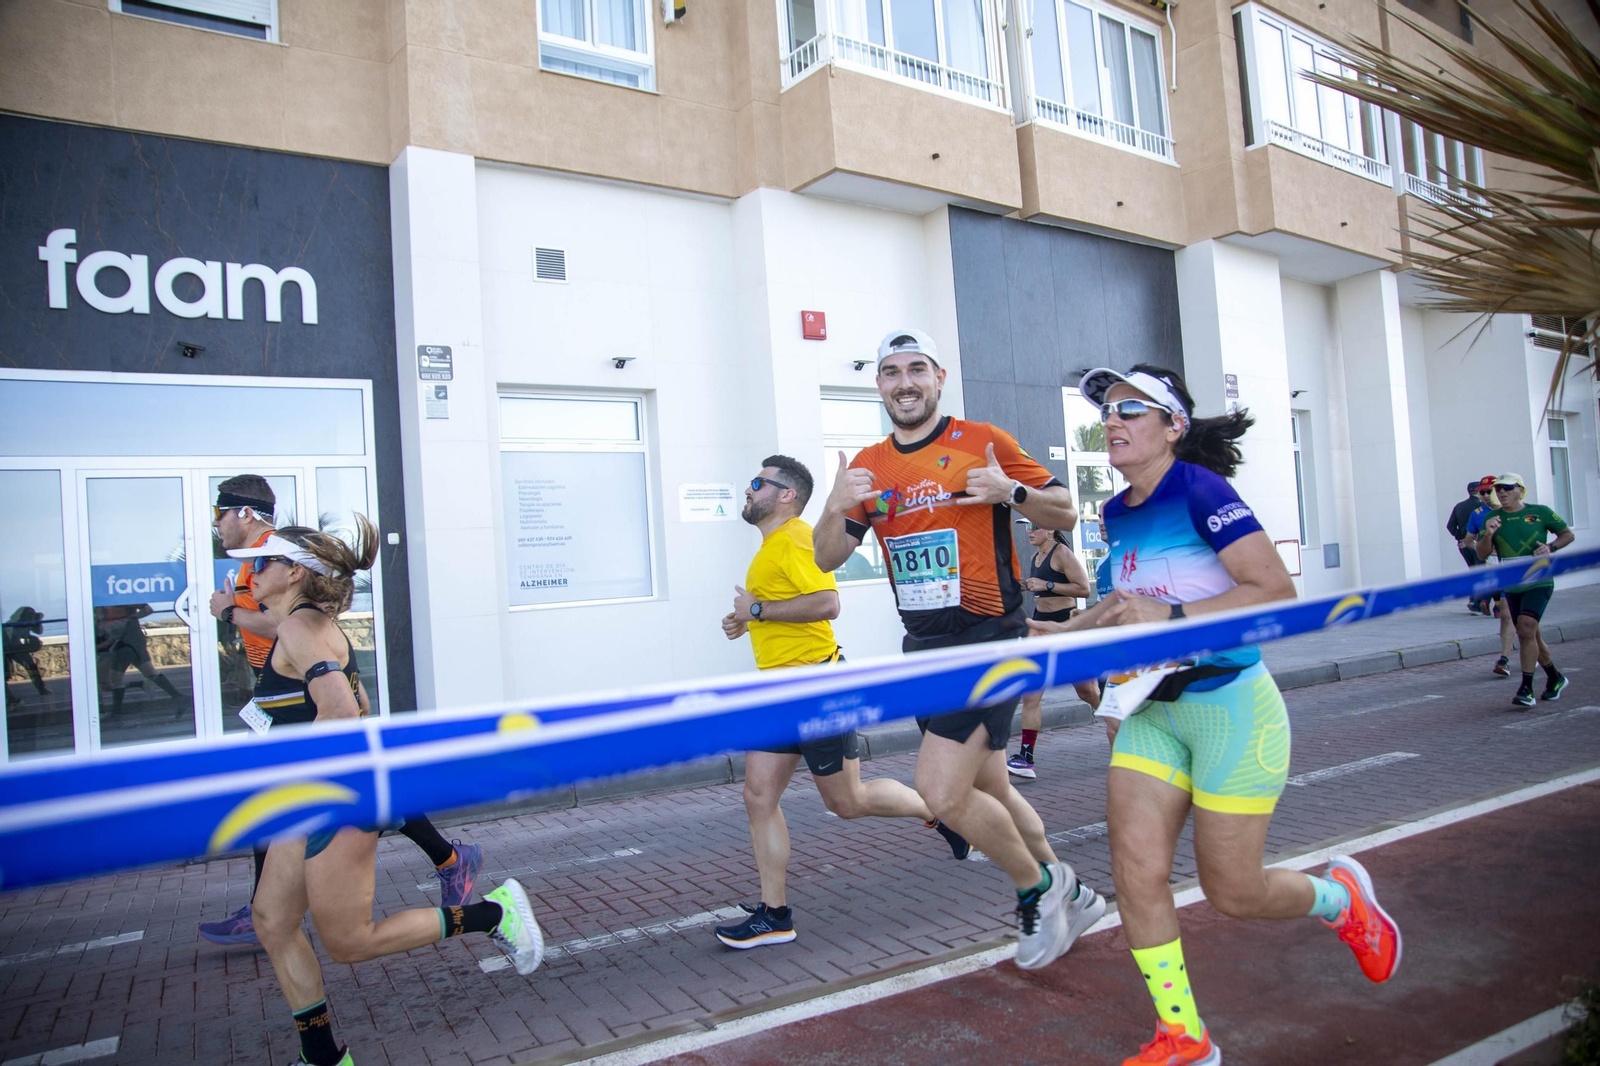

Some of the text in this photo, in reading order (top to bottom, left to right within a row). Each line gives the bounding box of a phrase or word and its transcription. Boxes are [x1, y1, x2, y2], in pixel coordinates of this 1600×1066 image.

[38, 228, 318, 325] faam
[892, 546, 950, 573] 1810
[106, 575, 175, 595] faam
[520, 578, 568, 587] ALZHEIMER
